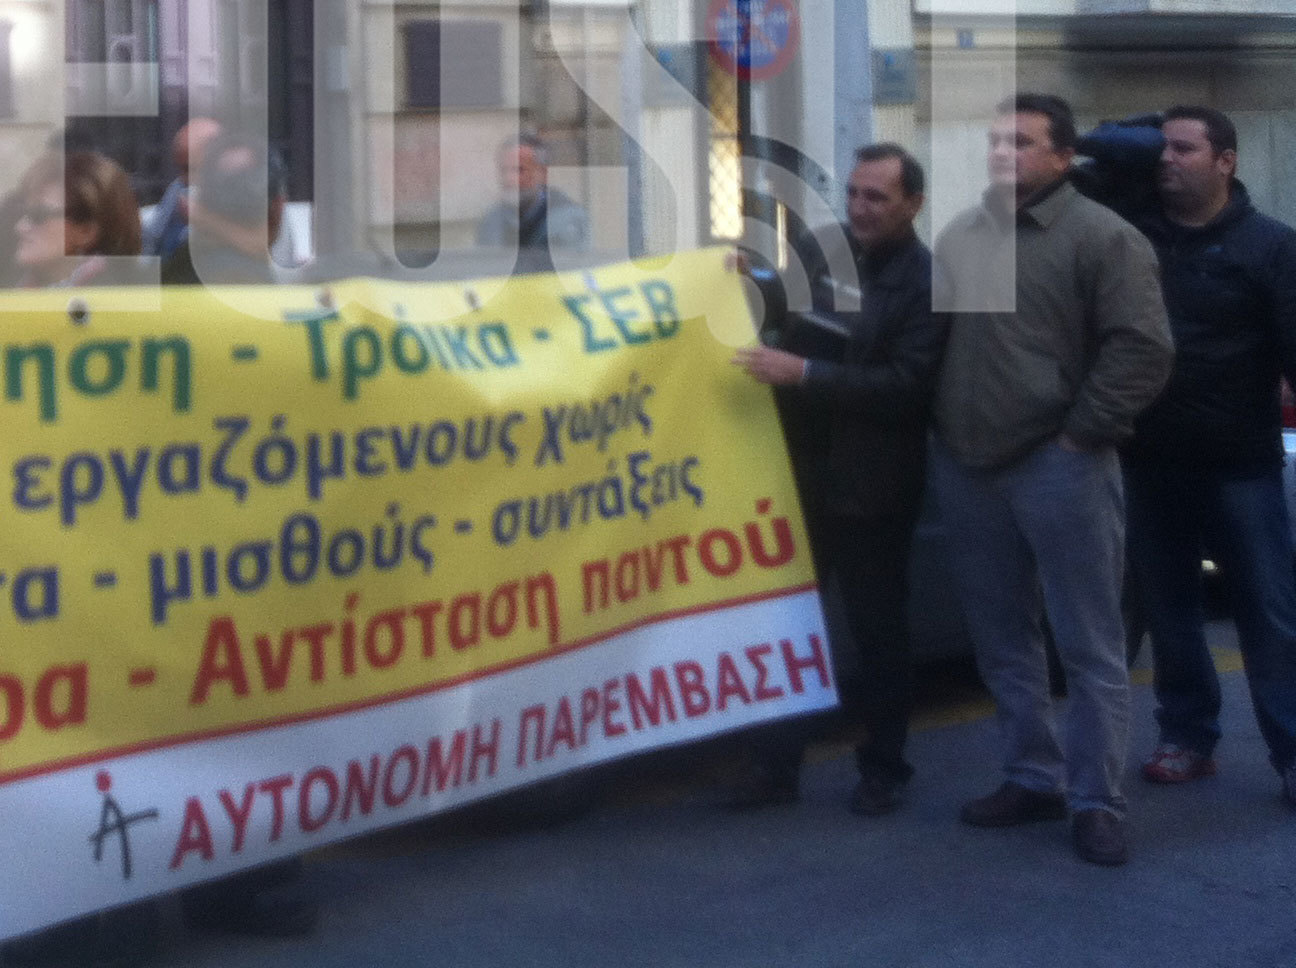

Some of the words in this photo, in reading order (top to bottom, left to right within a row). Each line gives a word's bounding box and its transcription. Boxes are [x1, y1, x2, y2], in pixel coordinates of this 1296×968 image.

[283, 300, 520, 401] Τρόικα
[561, 279, 682, 354] ΣΕΒ
[12, 412, 524, 528] εργαζόμενους
[534, 371, 655, 467] χωρίς
[148, 503, 436, 626] μισθούς
[490, 450, 705, 547] συντάξεις
[187, 572, 564, 708] Αντίσταση
[581, 496, 798, 616] παντού
[169, 720, 501, 873] ΑΥΤΟΝΟΜΗ
[514, 633, 833, 770] ΠΑΡΕΜΒΑΣΗ
